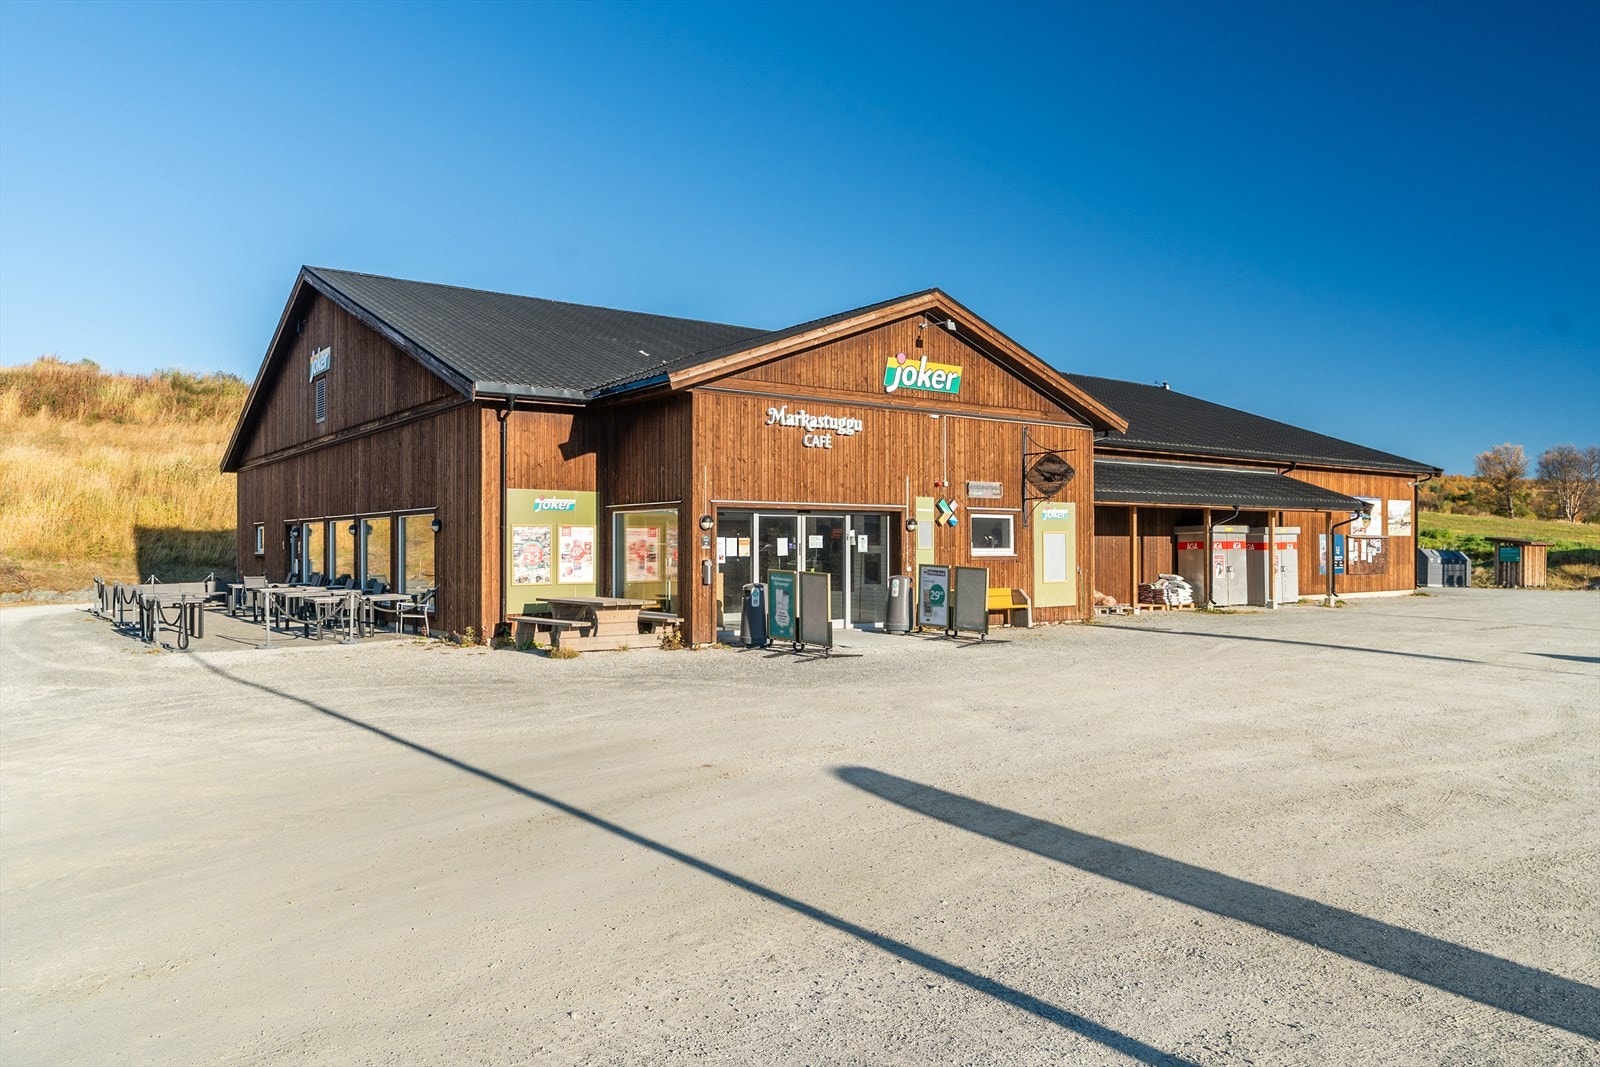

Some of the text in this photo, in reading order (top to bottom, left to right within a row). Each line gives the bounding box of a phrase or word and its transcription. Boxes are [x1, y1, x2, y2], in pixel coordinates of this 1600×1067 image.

[309, 346, 329, 383] joker
[885, 352, 960, 394] joker
[767, 404, 864, 436] Markastuggu
[534, 495, 575, 513] joker
[1042, 506, 1067, 521] joker
[1186, 542, 1198, 550] AGA
[1232, 541, 1242, 549] AGA
